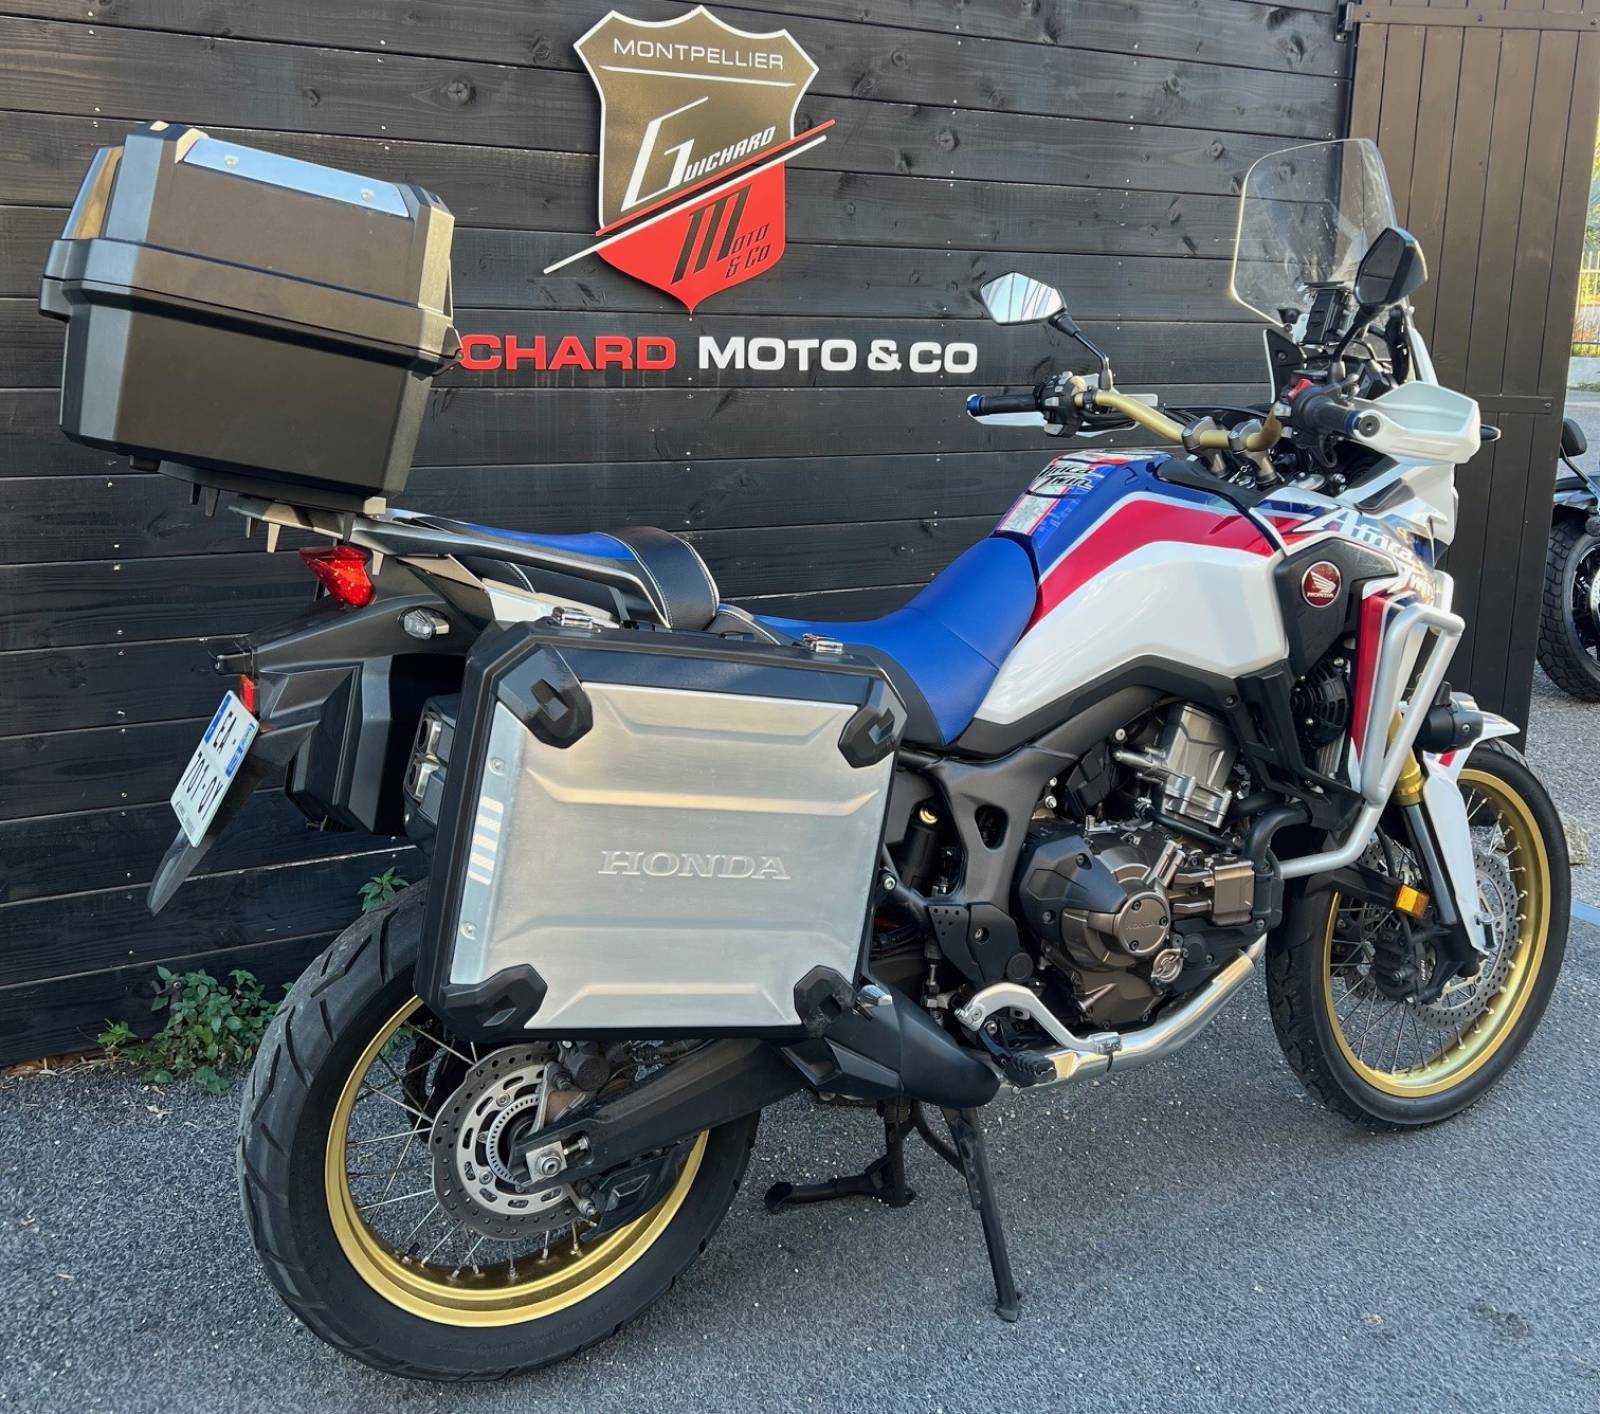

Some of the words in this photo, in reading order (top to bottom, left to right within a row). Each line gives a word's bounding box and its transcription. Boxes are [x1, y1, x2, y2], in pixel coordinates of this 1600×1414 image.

[613, 38, 784, 70] MONTPELLIER
[460, 334, 677, 370] CHARD
[700, 336, 858, 371] MOTO
[909, 342, 978, 374] CO
[598, 850, 791, 880] HONDA
